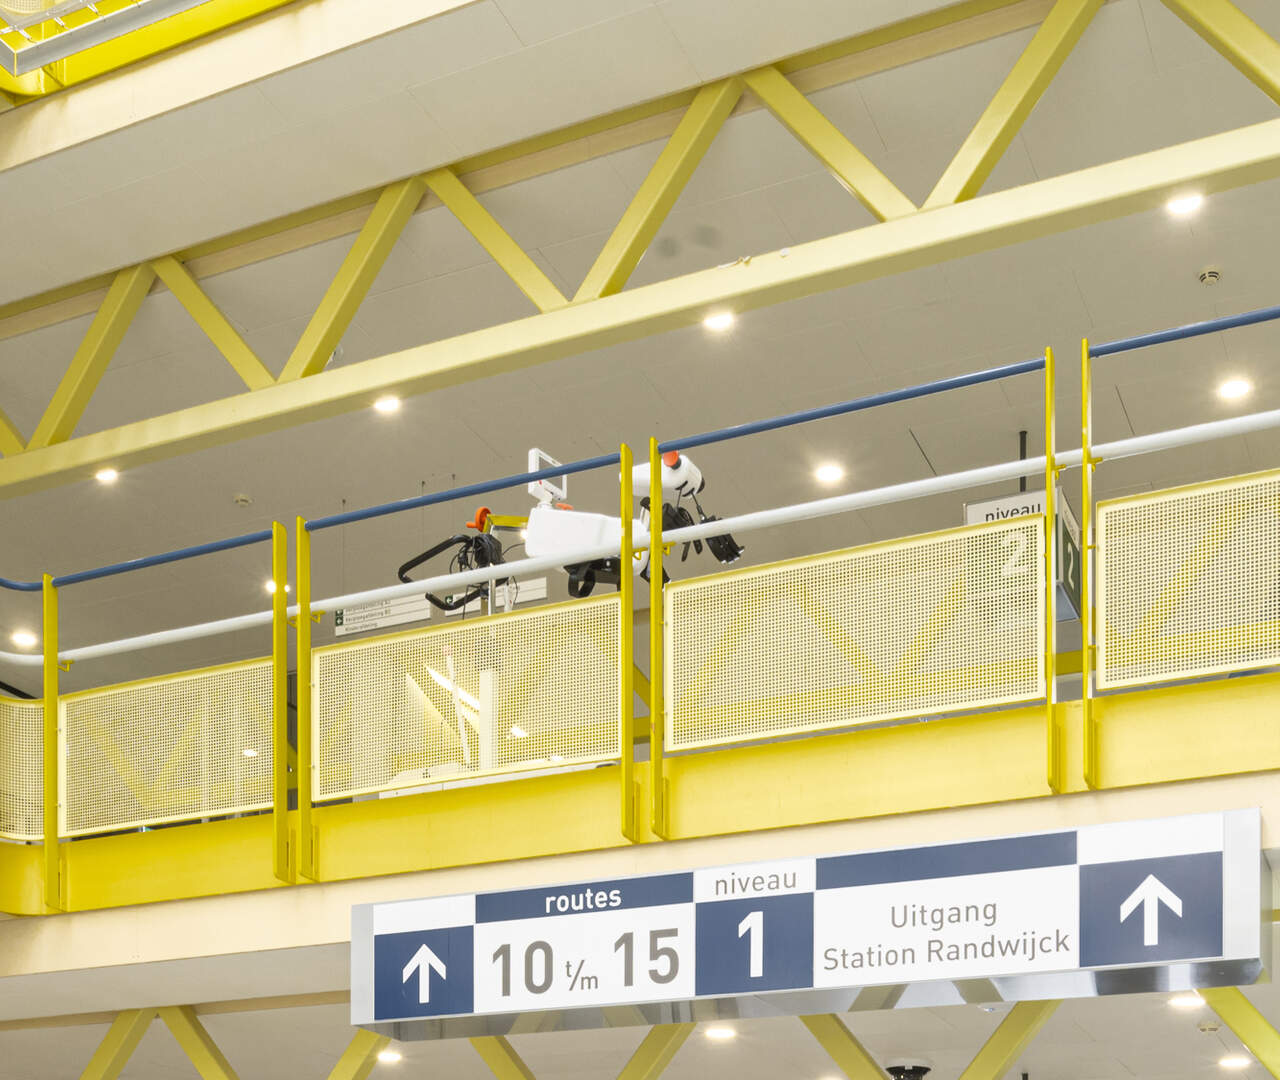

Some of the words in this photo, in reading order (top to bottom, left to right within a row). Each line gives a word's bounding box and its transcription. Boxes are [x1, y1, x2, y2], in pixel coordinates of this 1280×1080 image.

[985, 503, 1041, 522] niveau
[714, 871, 798, 896] niveau
[545, 888, 622, 913] routes
[890, 902, 998, 932] Uitgang
[738, 910, 764, 978] 1
[823, 943, 916, 971] Station
[926, 929, 1071, 963] Randwijck
[492, 940, 554, 997] 10
[565, 959, 599, 991] t/m
[614, 927, 680, 987] 15
